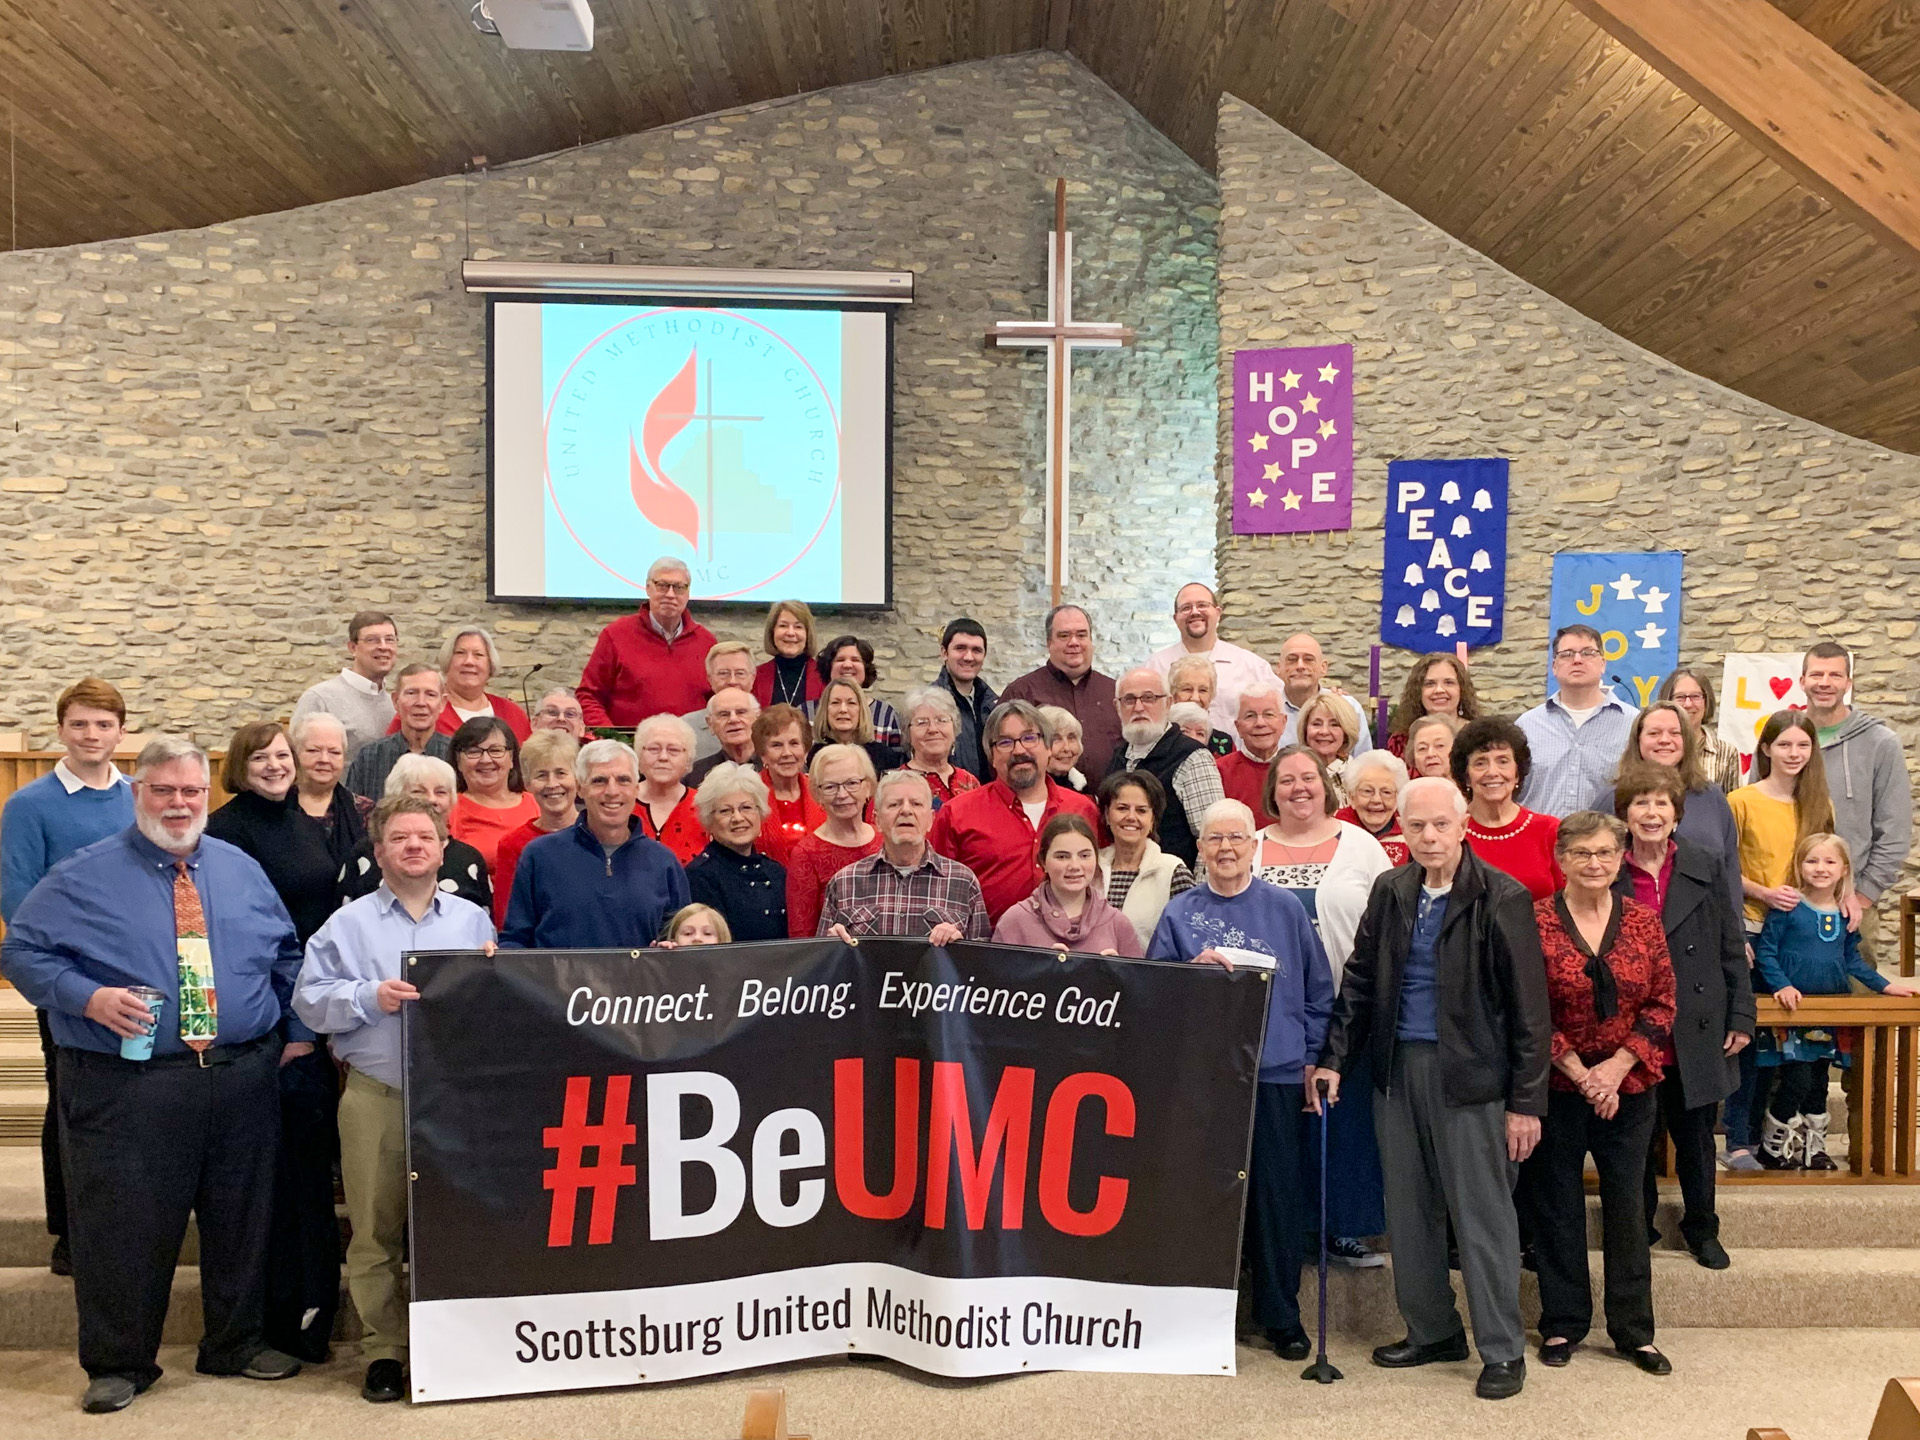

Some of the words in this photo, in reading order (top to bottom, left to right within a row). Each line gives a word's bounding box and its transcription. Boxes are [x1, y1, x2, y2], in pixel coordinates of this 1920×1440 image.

[562, 368, 598, 479] UNITED
[606, 316, 777, 362] METHODIST
[783, 367, 826, 485] CHURCH
[1249, 371, 1336, 503] HOPE
[696, 565, 729, 583] MC
[1397, 481, 1493, 627] PEACE
[1576, 584, 1660, 708] JOY
[566, 983, 714, 1026] Connect.
[737, 976, 856, 1020] Belong.
[878, 971, 1046, 1020] Experience
[1055, 986, 1122, 1028] God.
[543, 1057, 1136, 1247] #BeUMC
[515, 1314, 724, 1363] Scottsburg
[736, 1288, 851, 1341] United
[867, 1286, 1011, 1349] Methodist
[1022, 1302, 1142, 1350] Church
